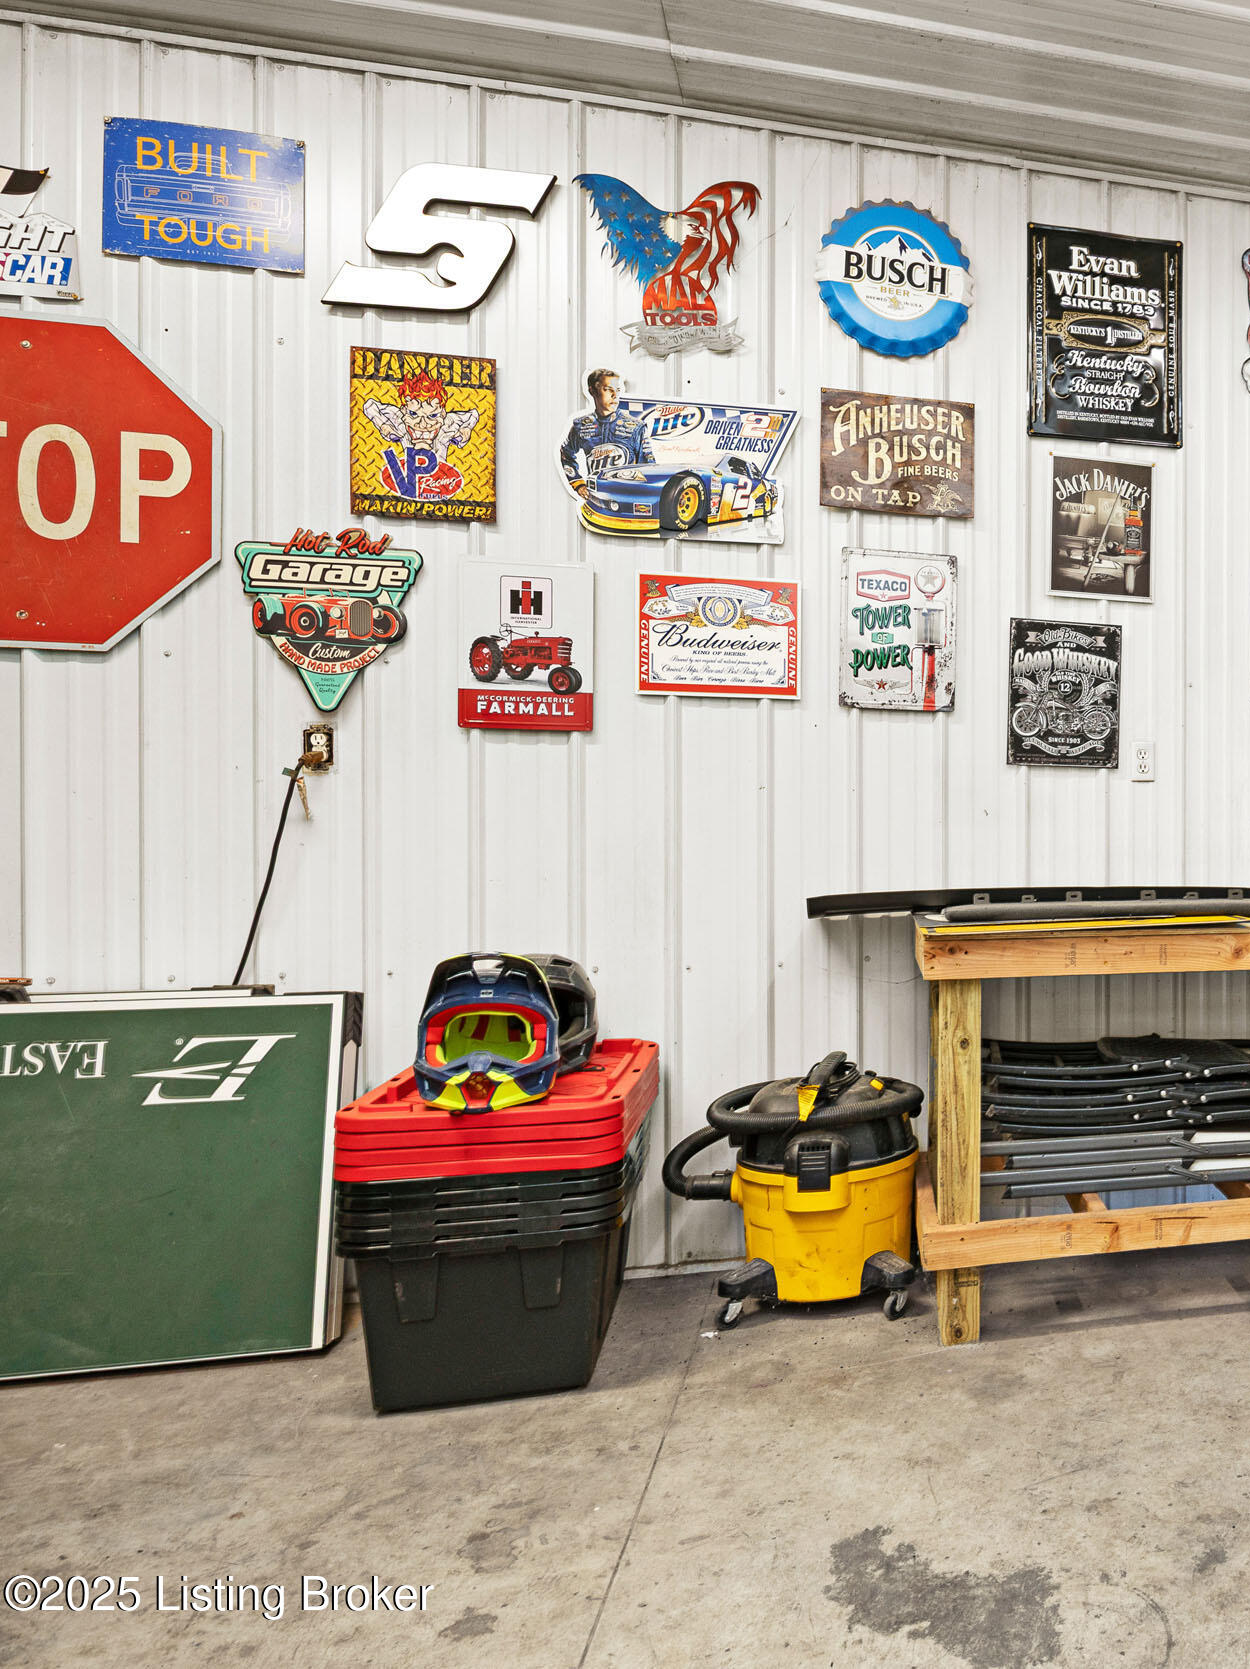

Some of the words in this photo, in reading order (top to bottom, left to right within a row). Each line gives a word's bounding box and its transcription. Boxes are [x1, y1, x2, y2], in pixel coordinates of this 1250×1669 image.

[136, 136, 269, 183] BUILT
[135, 214, 270, 253] TOUGH
[844, 250, 948, 296] BUSCH
[1069, 246, 1140, 277] Evan
[881, 286, 910, 297] BEER
[646, 312, 717, 326] TOOLS
[1061, 296, 1113, 313] SINCE
[1117, 302, 1156, 318] 1783
[354, 350, 492, 386] DANGER
[1066, 350, 1144, 377] Kentucky
[1086, 370, 1125, 381] STRAIGHT
[1070, 376, 1141, 398] Bourbon
[656, 405, 688, 416] Miller
[1078, 395, 1134, 412] WHISKEY
[651, 411, 696, 437] Lite
[704, 420, 743, 436] DRIVEN
[829, 400, 966, 456] ANHEUSER
[715, 436, 774, 453] GREATNESS
[381, 447, 438, 498] VP
[851, 435, 962, 485] BUSCH
[0, 421, 192, 544] OP
[420, 476, 462, 493] Racing
[898, 466, 921, 478] FINE
[924, 465, 959, 482] BEERS
[831, 486, 863, 502] ON
[872, 488, 921, 507] TAP
[1055, 473, 1092, 500] JACK
[1093, 468, 1150, 510] DANIEL'S
[354, 499, 421, 514] MAKIN'
[422, 500, 492, 518] POWER!
[283, 528, 331, 554] Hot
[335, 528, 390, 556] Rod
[249, 554, 410, 592] Garage
[859, 578, 907, 592] TEXACO
[852, 603, 912, 636] TOWER
[652, 622, 781, 651] Budweiser
[877, 633, 889, 643] OF
[279, 642, 306, 665] HAND
[307, 659, 337, 673] MADE
[340, 646, 381, 673] PROJECT
[309, 643, 350, 659] Custom
[640, 619, 649, 683] GENUINE
[788, 627, 797, 688] GENUINE
[849, 644, 913, 677] POWER
[1013, 648, 1053, 677] GOOD
[1051, 675, 1080, 684] WHISKEY
[1060, 683, 1070, 692] 12
[476, 701, 575, 716] FARMALL
